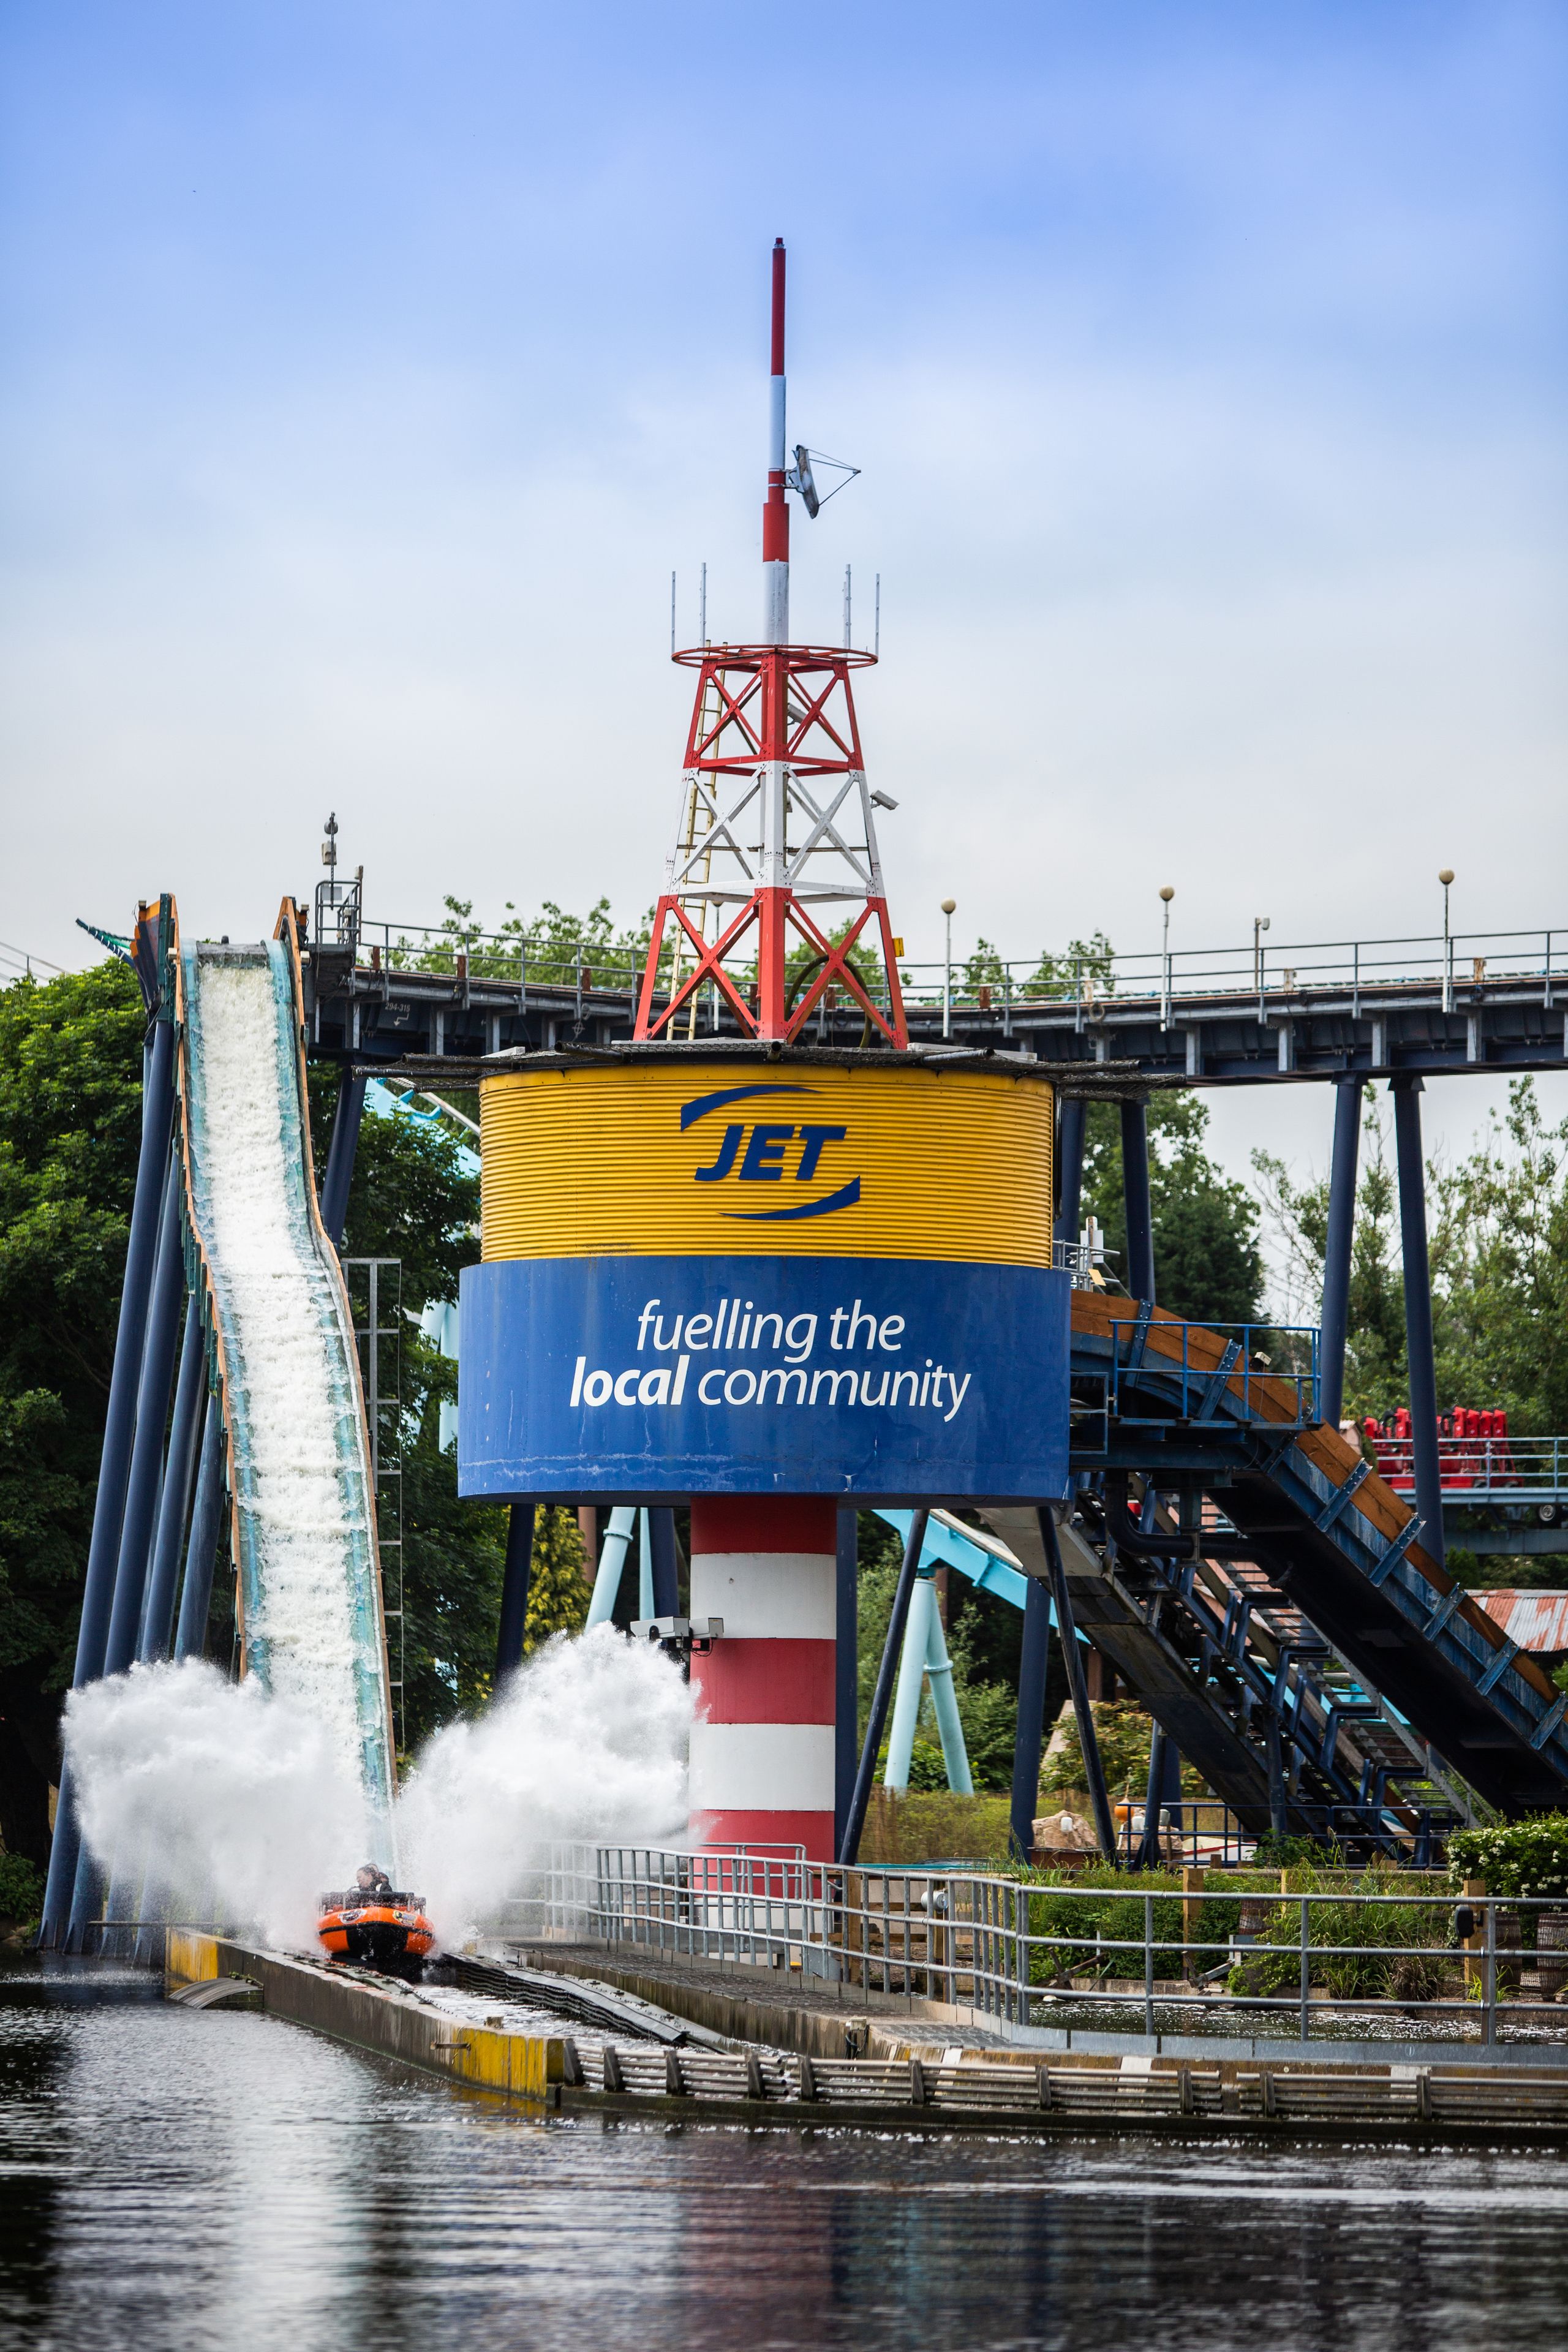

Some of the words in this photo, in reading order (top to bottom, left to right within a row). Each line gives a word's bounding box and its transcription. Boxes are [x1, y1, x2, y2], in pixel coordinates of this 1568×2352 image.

[695, 1126, 846, 1181] JET
[637, 1299, 818, 1363] fuelling
[830, 1299, 905, 1351] the
[570, 1355, 690, 1407] local
[698, 1359, 971, 1422] community
